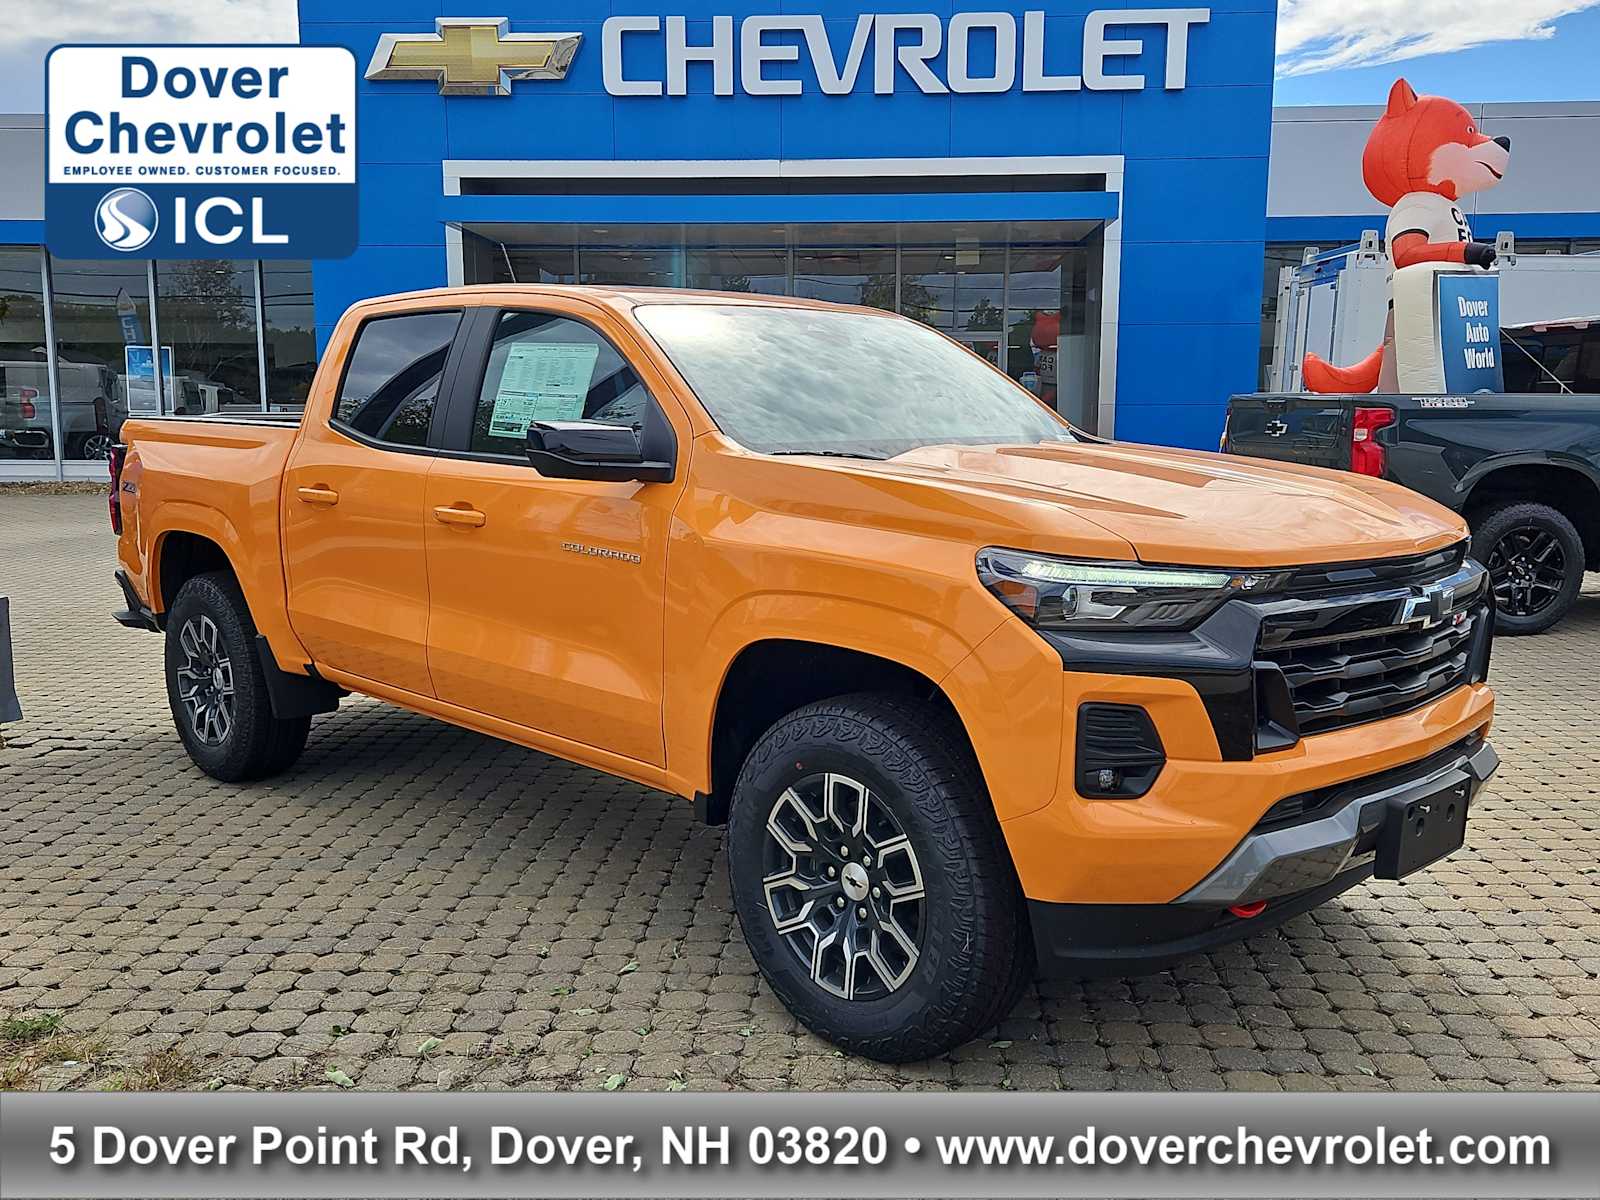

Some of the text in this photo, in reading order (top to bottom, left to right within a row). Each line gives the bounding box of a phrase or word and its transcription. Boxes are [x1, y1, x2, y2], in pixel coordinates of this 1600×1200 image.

[602, 8, 1211, 96] CHEVROLET
[1457, 296, 1489, 318] Dover
[1465, 322, 1490, 343] Auto
[1463, 347, 1496, 370] World
[560, 541, 642, 564] COLORADO
